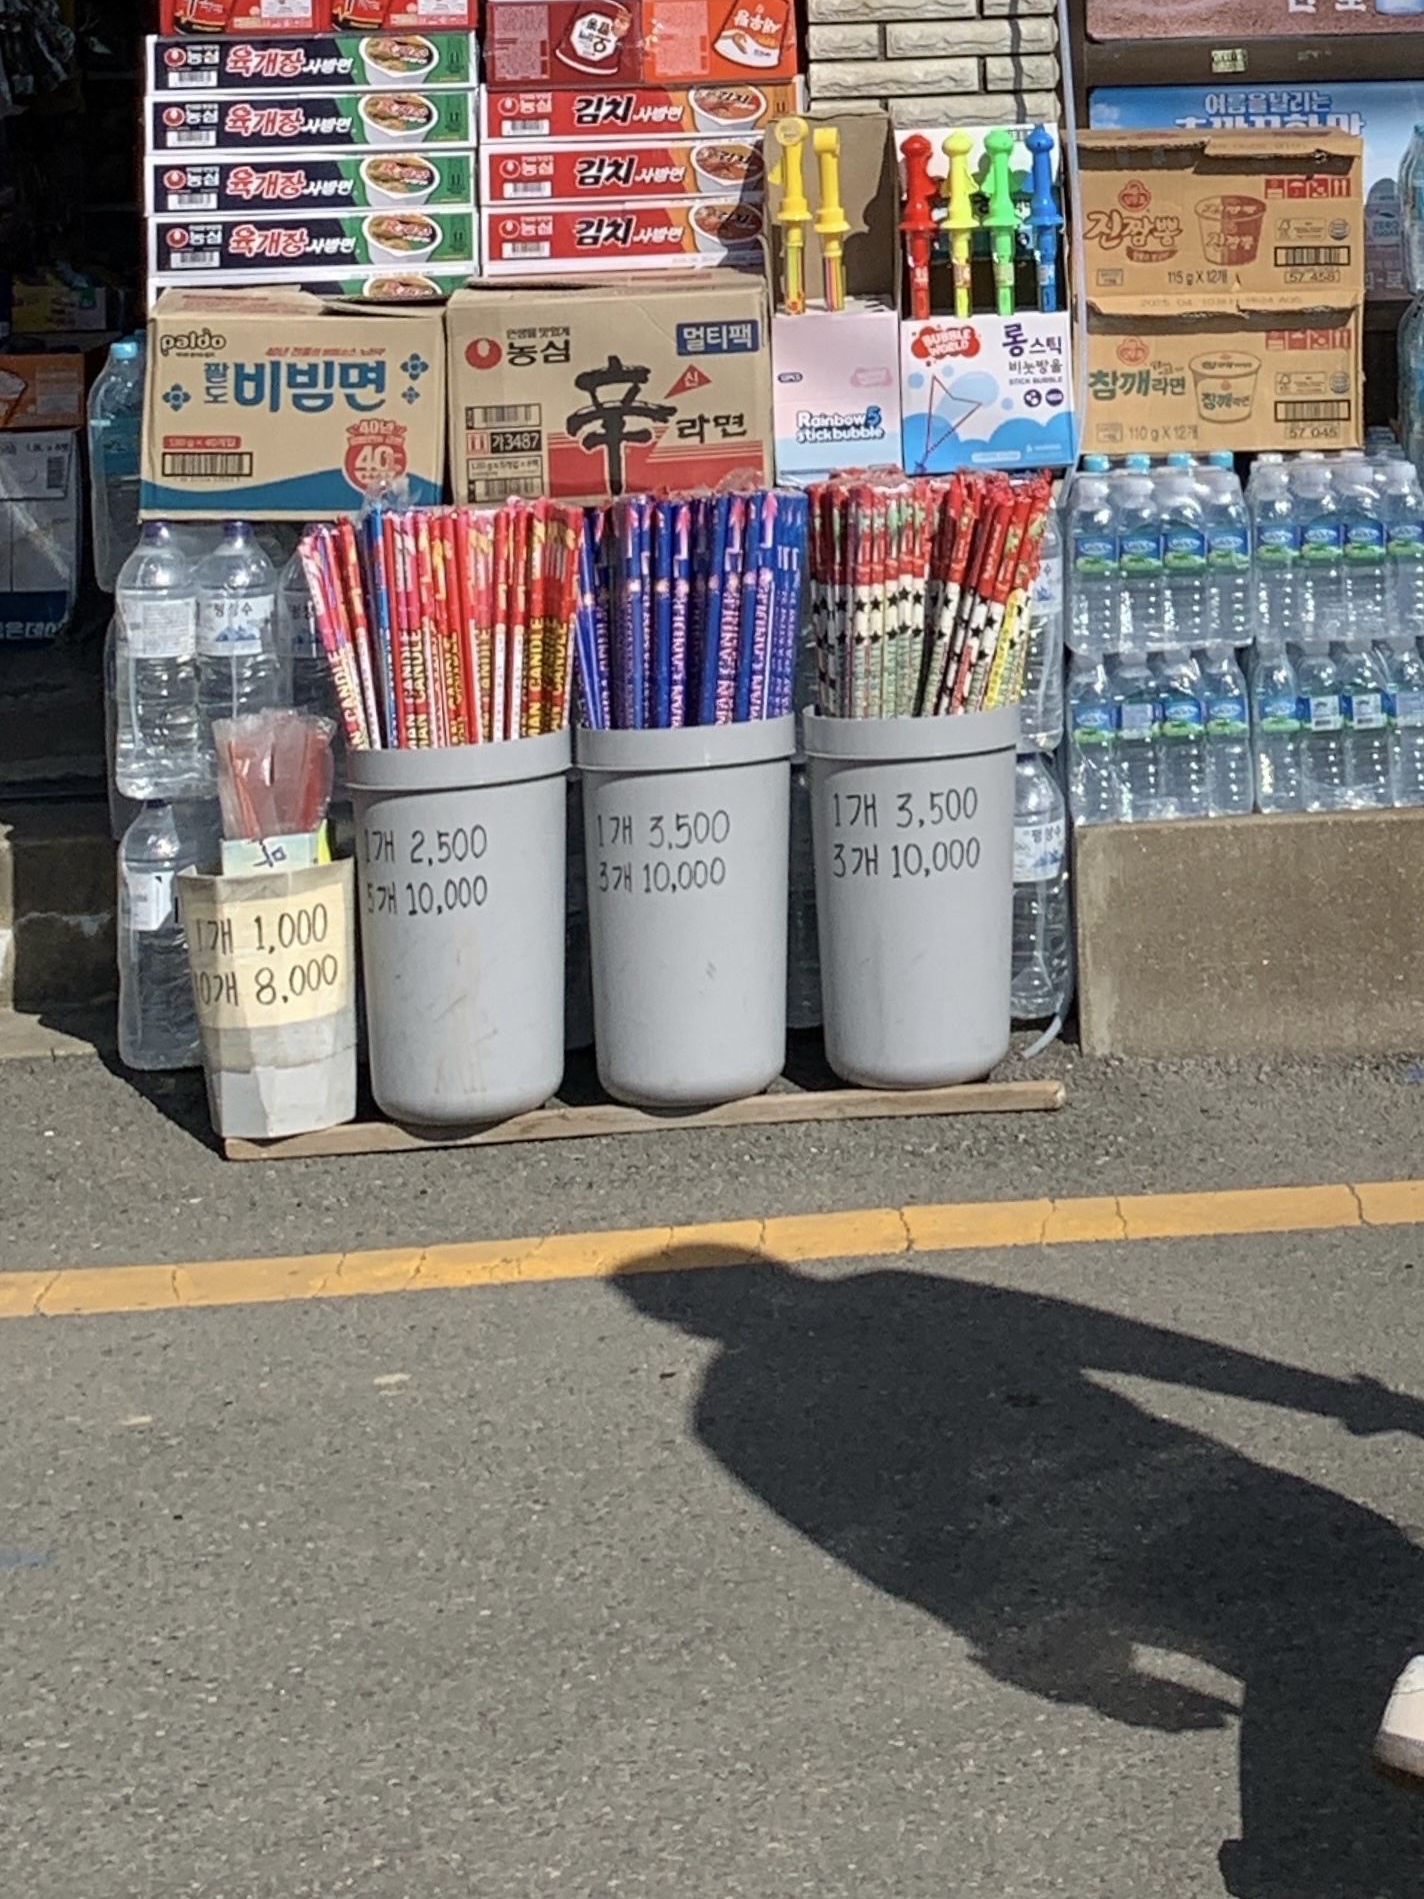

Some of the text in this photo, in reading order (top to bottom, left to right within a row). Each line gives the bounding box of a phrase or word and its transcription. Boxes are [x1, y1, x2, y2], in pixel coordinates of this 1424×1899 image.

[225, 44, 304, 79] 육개장
[224, 103, 303, 137] 육개장
[573, 94, 635, 127] 김치
[226, 166, 306, 199] 육개장
[574, 156, 638, 188] 김치
[228, 224, 308, 257] 육개장
[573, 215, 637, 249] 김치
[1085, 209, 1184, 250] 진짬뽕
[161, 328, 226, 357] paldo
[507, 339, 570, 367] 농심
[683, 323, 752, 351] 멀티팩
[204, 362, 230, 403] 팔도
[684, 370, 700, 388] 신
[1009, 359, 1063, 375] 비눗방울
[233, 360, 387, 413] 비빔면
[359, 419, 394, 434] 40년
[567, 355, 677, 496] 辛
[676, 413, 748, 444] 라면
[797, 410, 867, 429] Rainbow
[413, 628, 428, 704] CANDLE
[529, 618, 544, 691] CANDLE
[327, 650, 357, 724] CANDLE
[896, 786, 979, 829] 3,500
[409, 824, 488, 867] 2,500
[648, 809, 730, 851] 3,500
[643, 857, 726, 893] 10,000
[891, 836, 981, 879] 10,000
[405, 874, 488, 917] 10,000
[254, 902, 328, 955] 1,000
